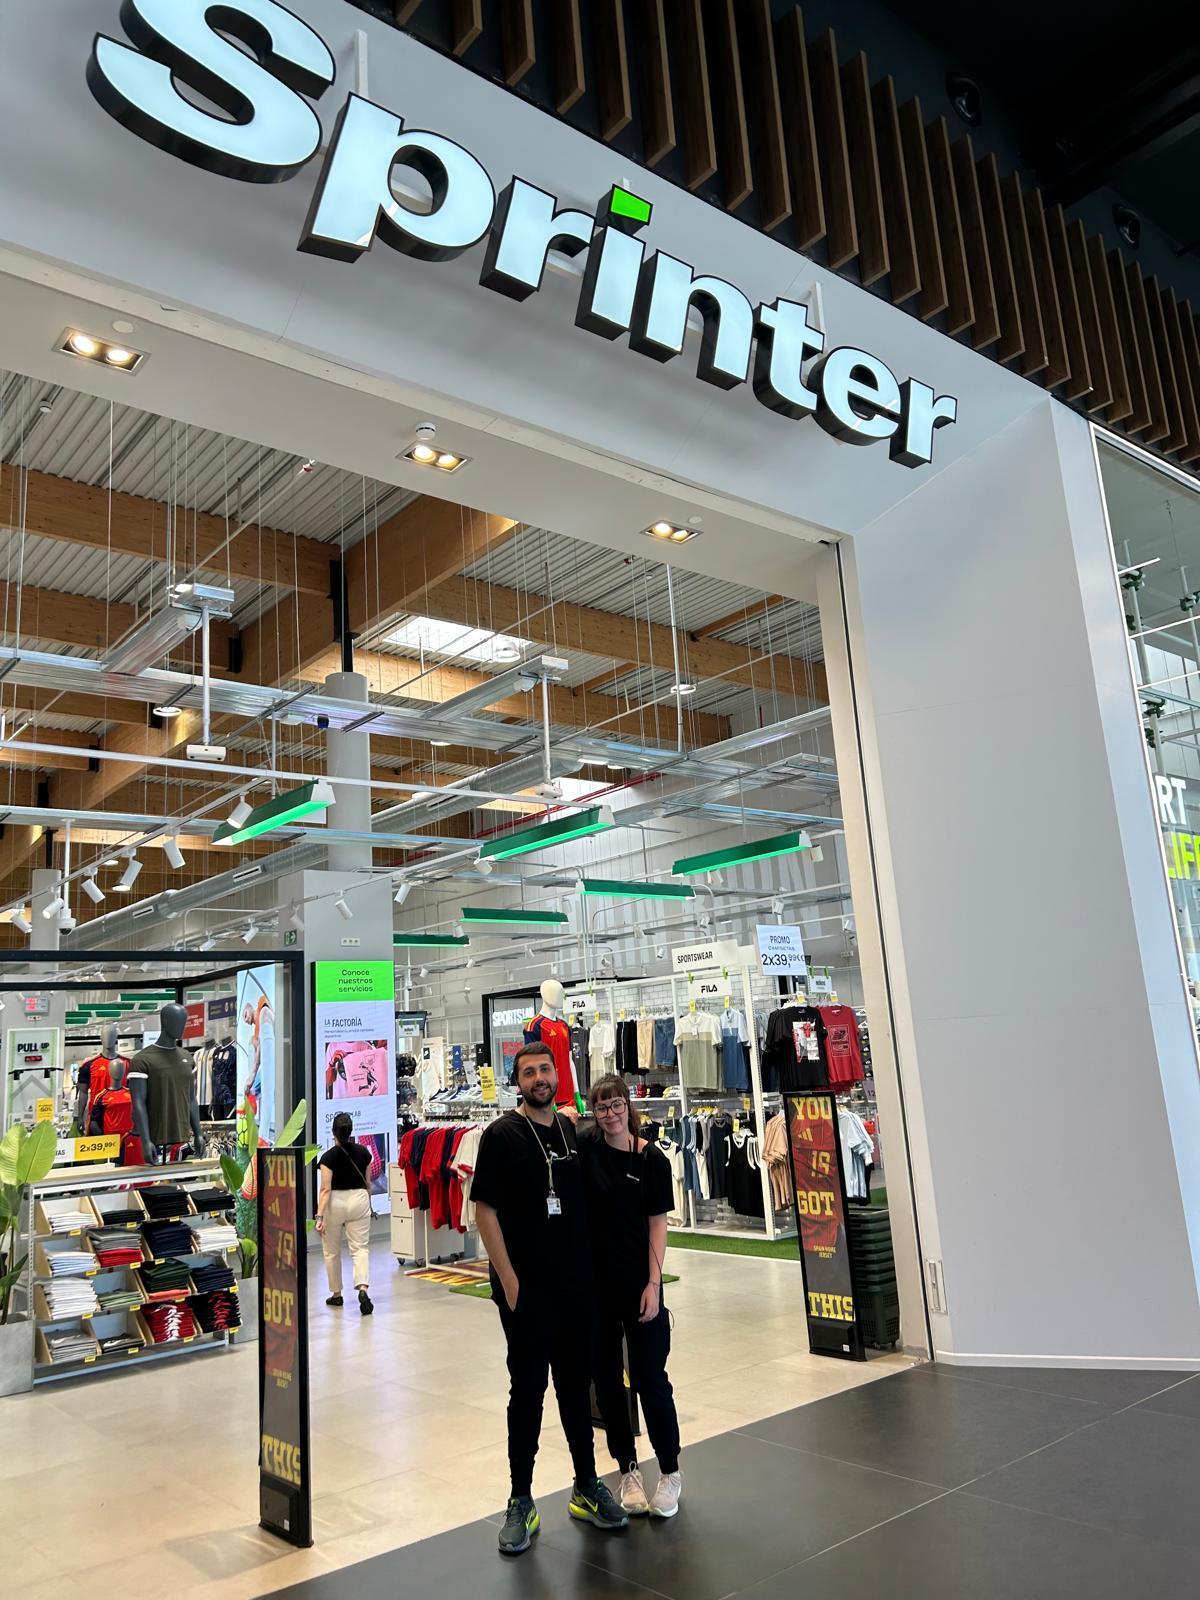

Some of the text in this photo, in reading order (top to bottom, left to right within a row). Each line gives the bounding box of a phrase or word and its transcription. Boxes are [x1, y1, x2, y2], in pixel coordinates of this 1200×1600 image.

[86, 0, 957, 464] Sprinter
[770, 935, 791, 944] PROMO
[677, 950, 713, 964] SPORTSWEAR
[341, 968, 370, 976] Conoce
[338, 977, 373, 985] nuestros
[338, 985, 373, 993] servicios
[701, 984, 718, 993] FILA
[572, 1000, 586, 1009] FILA
[324, 1016, 362, 1027] LA FACTORÍA
[17, 1042, 50, 1053] PULL UP
[792, 1097, 833, 1121] YOU
[266, 1155, 297, 1188] YOU
[796, 1190, 835, 1216] GOT
[263, 1287, 294, 1326] GOT
[808, 1291, 855, 1321] THIS
[261, 1434, 301, 1485] THIS
